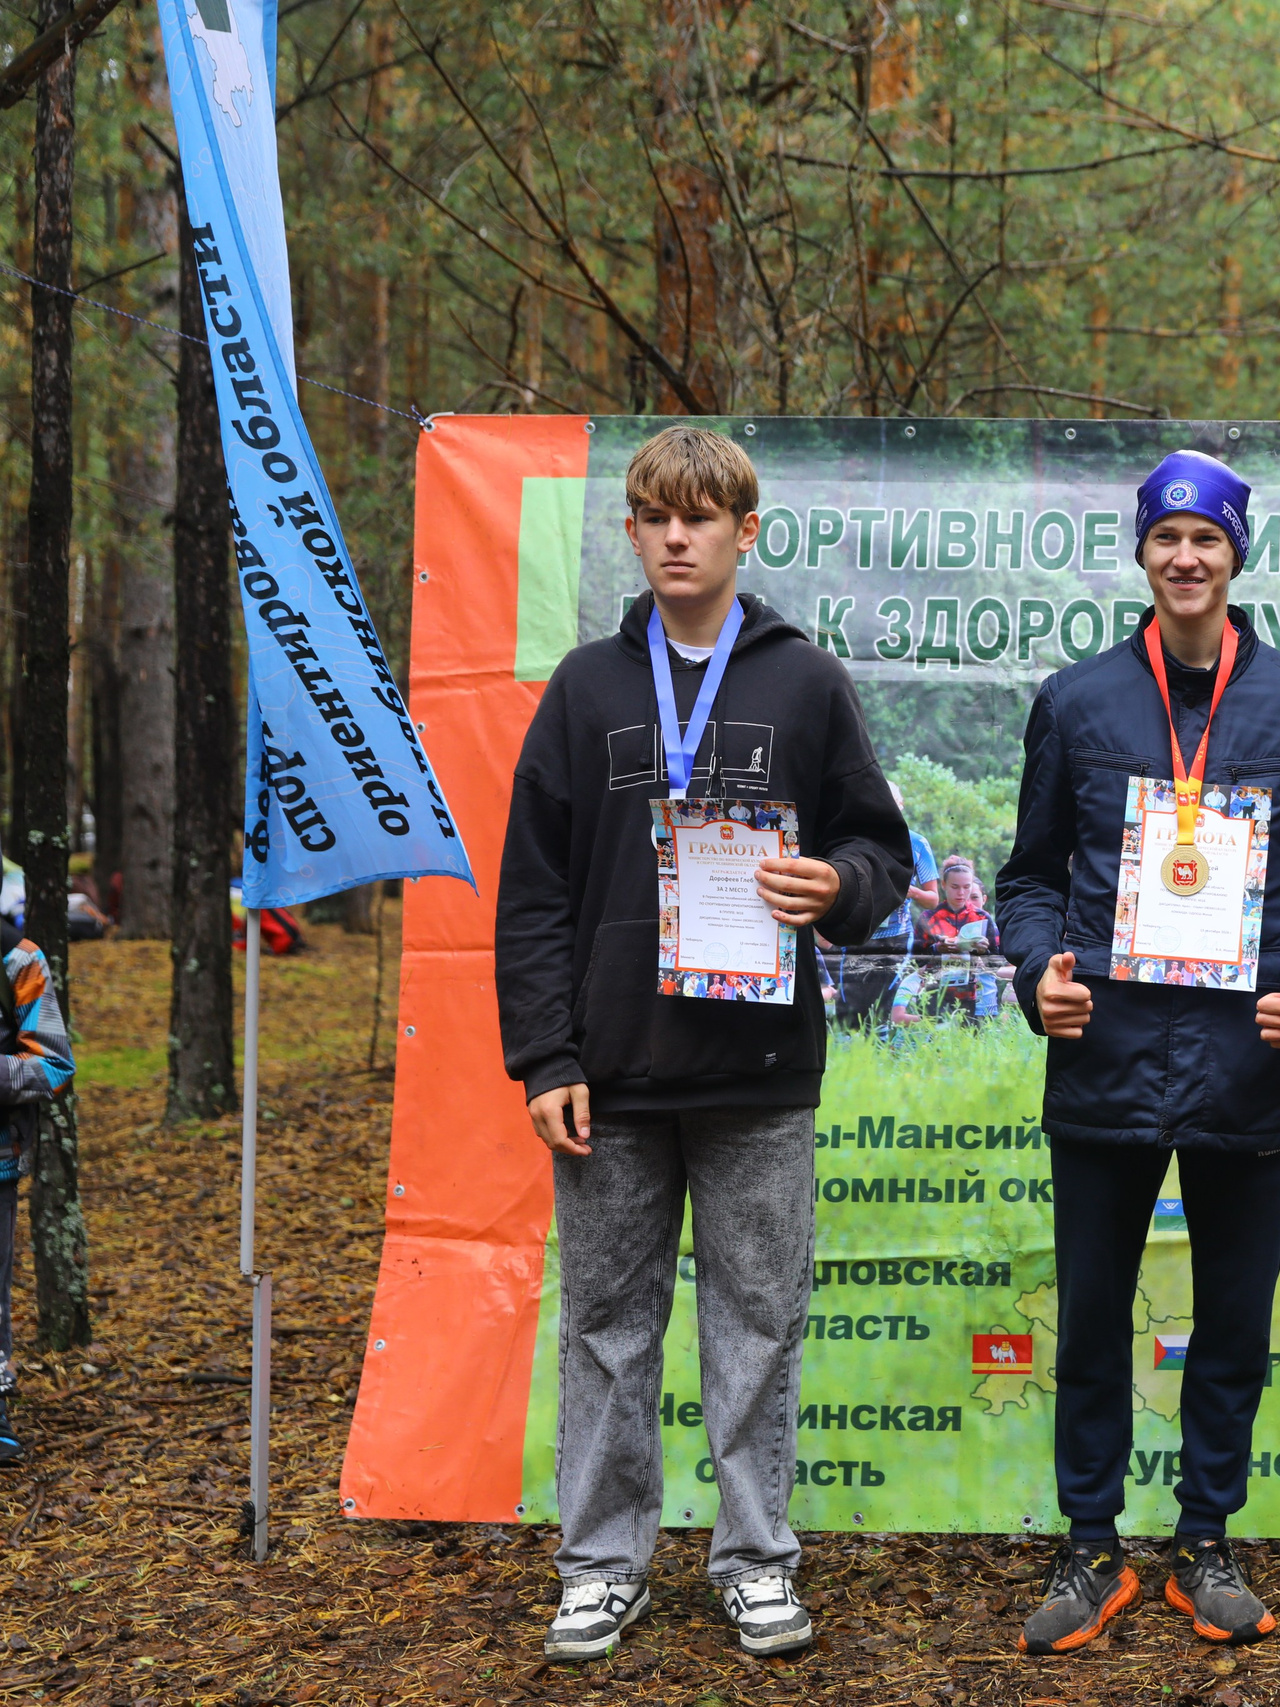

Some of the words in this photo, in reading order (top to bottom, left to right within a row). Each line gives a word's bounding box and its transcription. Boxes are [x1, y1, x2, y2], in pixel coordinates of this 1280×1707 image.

[737, 506, 1119, 572] ОРТИВНОЕ
[815, 596, 855, 660] К
[688, 841, 769, 857] ГРАМОТА
[815, 1169, 985, 1203] омный
[803, 1313, 931, 1342] ласть
[657, 1392, 962, 1432] Чеинская
